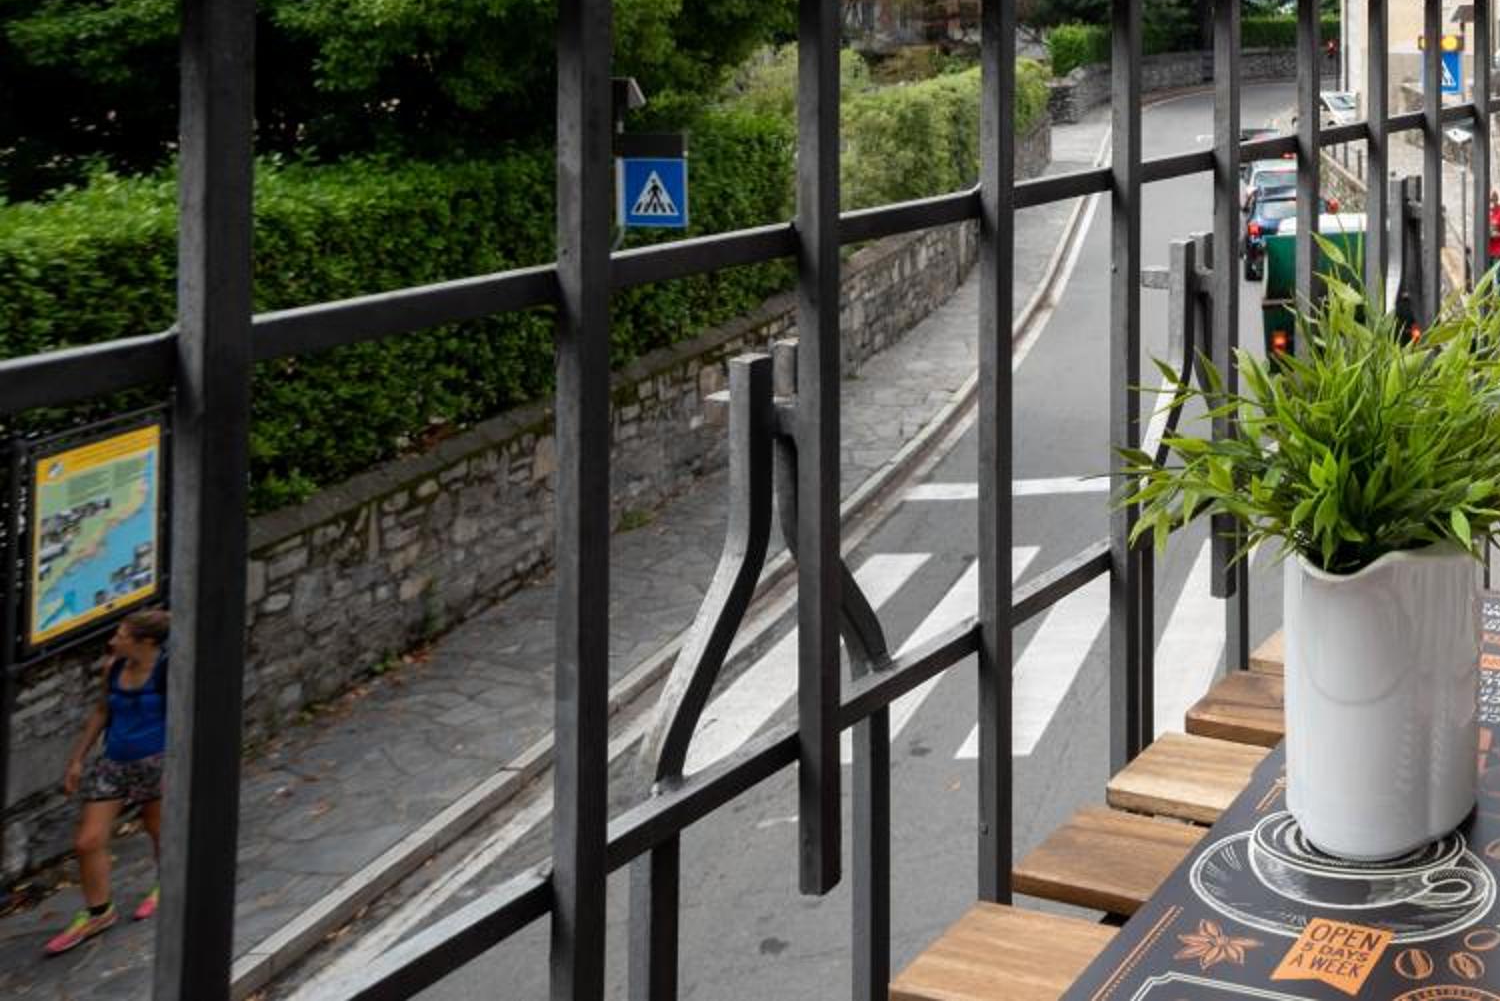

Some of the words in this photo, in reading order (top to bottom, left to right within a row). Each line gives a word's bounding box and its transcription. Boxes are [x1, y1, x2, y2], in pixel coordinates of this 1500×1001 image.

[1310, 923, 1382, 951] OPEN
[1288, 952, 1304, 967] A
[1309, 956, 1365, 978] WEEK
[1319, 944, 1370, 962] DAYS
